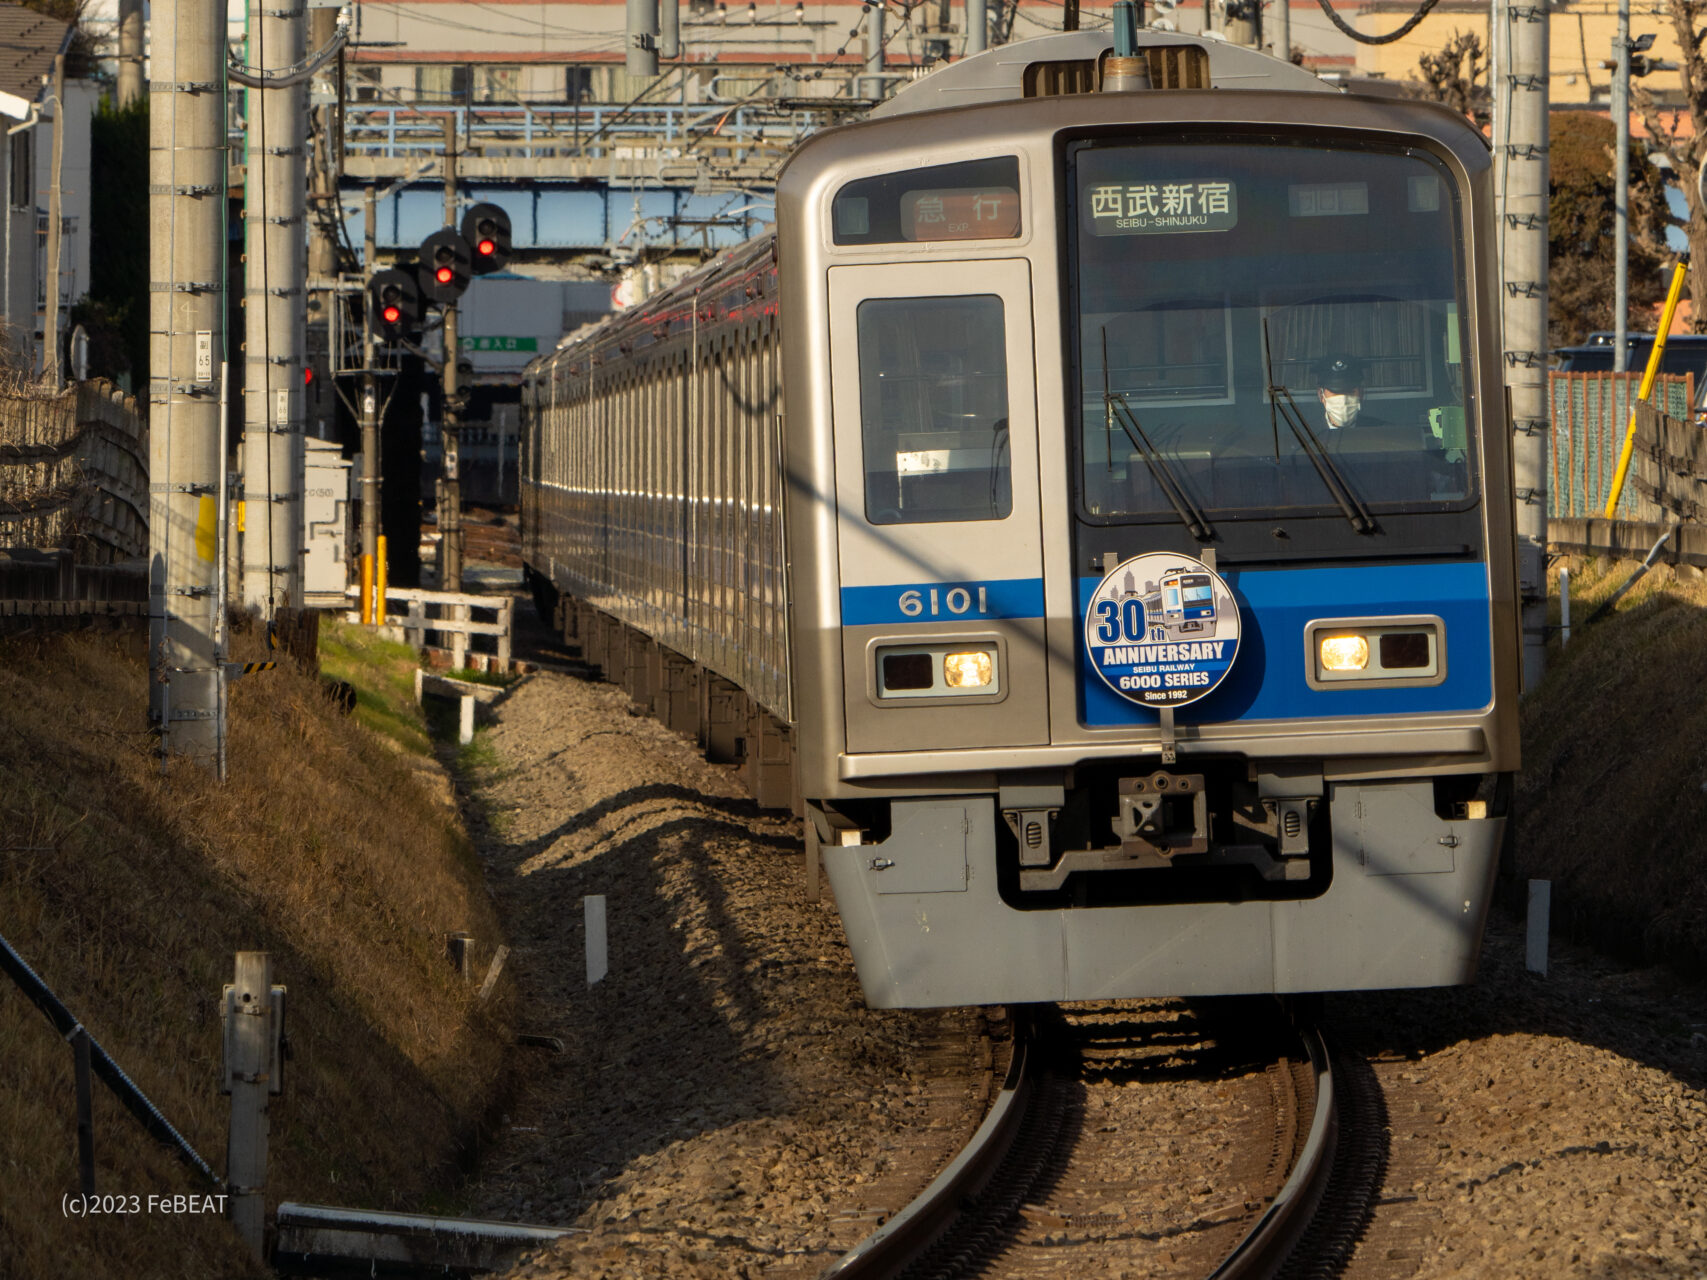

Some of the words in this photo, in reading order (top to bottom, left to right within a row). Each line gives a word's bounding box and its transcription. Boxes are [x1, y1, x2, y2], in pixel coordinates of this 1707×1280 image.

[916, 194, 1002, 223] 急行
[1091, 182, 1230, 219] 西武新宿
[1115, 214, 1208, 229] SEIBU-SHINJUKU
[198, 355, 210, 366] 65
[898, 586, 987, 617] 6101
[1103, 642, 1224, 666] ANNIVERSARY
[1132, 665, 1158, 674] SEIBU
[1159, 663, 1196, 673] RAILWAY
[1119, 675, 1161, 690] 6000
[1164, 672, 1210, 687] SERIES
[1144, 691, 1167, 701] Since
[1168, 690, 1188, 700] 1992
